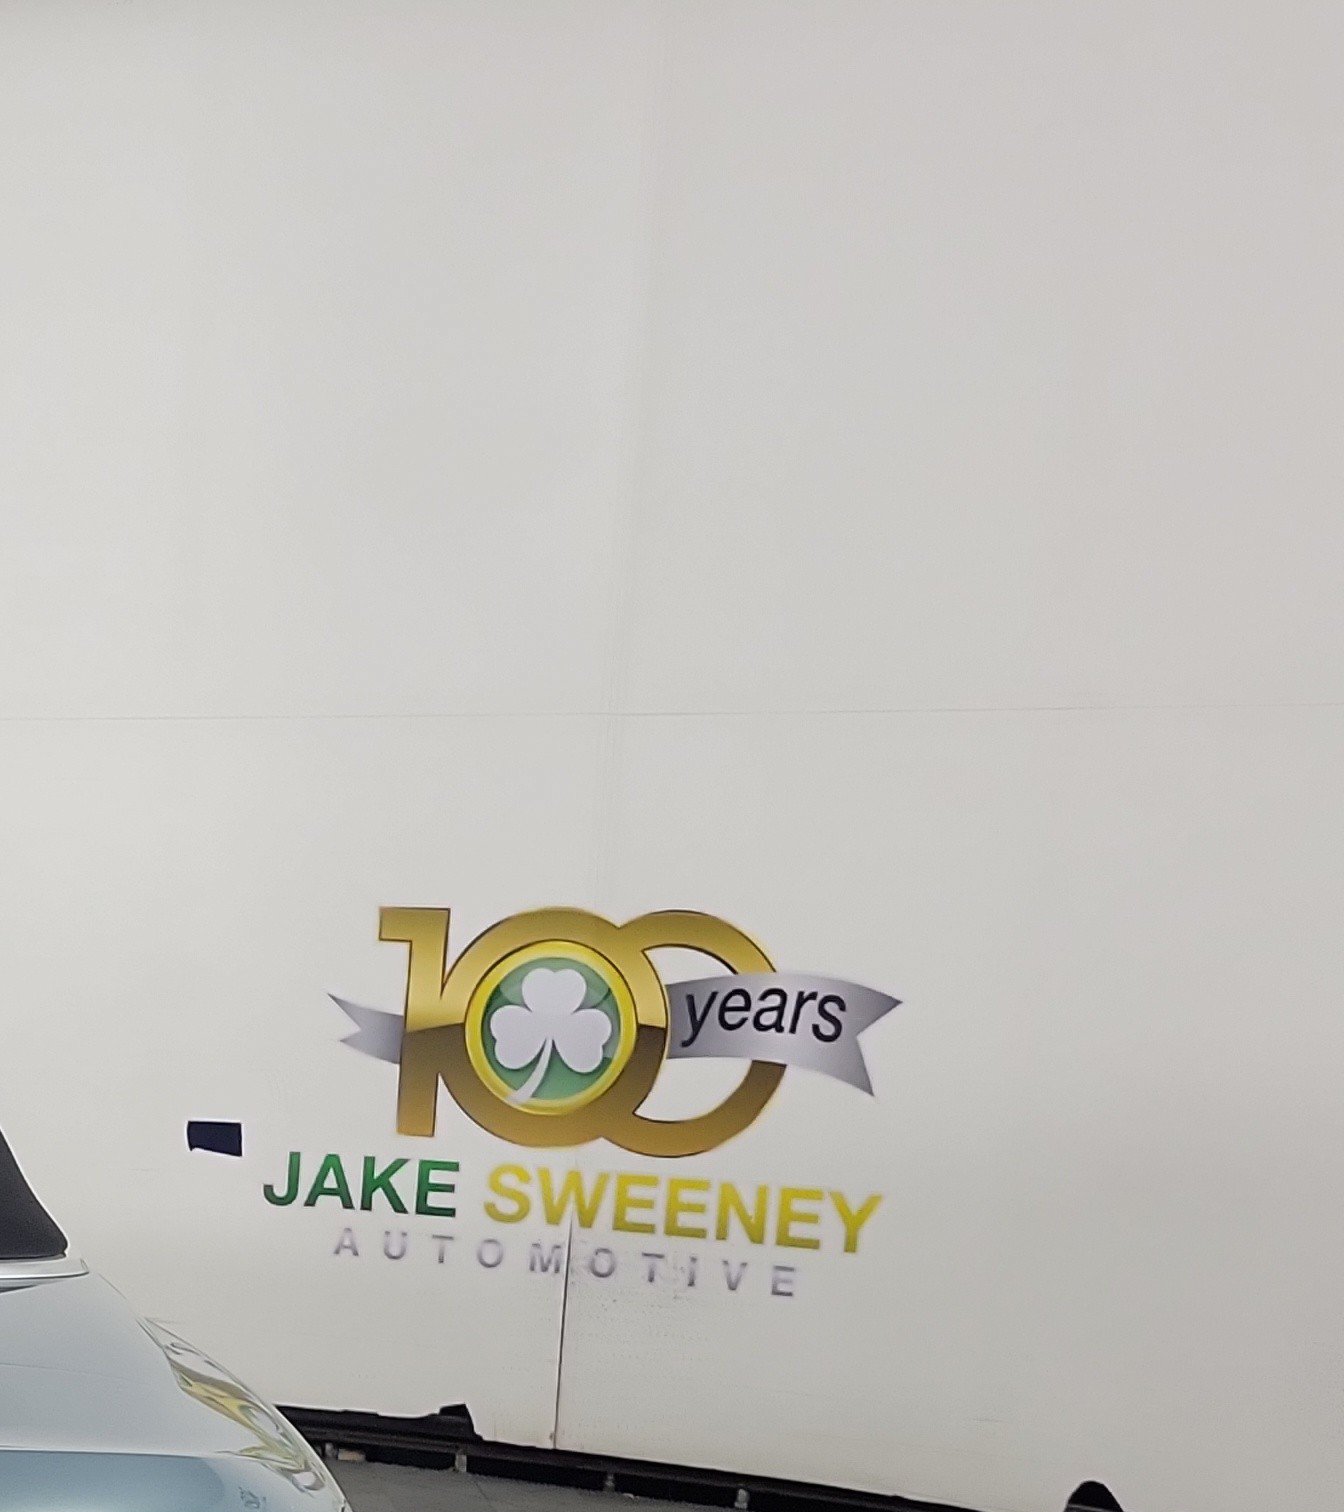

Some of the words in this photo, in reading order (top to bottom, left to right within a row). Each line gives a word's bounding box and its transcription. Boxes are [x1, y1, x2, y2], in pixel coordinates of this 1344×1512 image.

[378, 905, 788, 1158] 100
[679, 986, 847, 1048] years
[262, 1151, 461, 1218] JAKE
[482, 1162, 884, 1254] SWEENEY
[333, 1226, 797, 1297] AUTOMOTIVE
